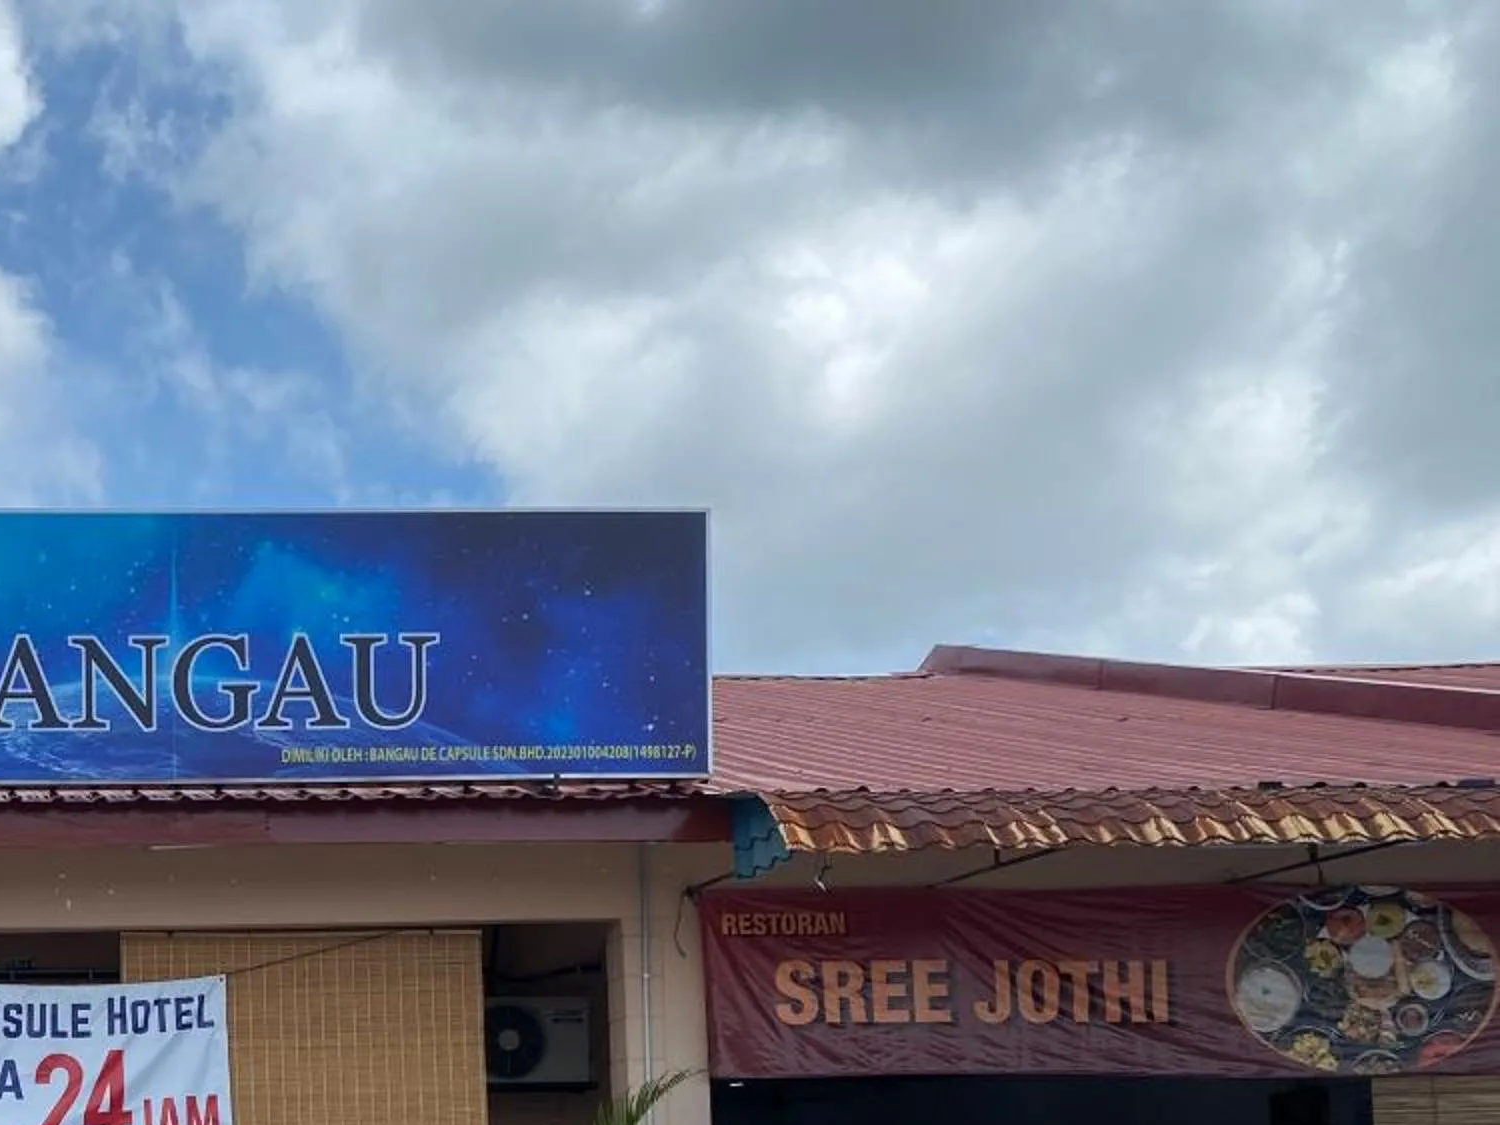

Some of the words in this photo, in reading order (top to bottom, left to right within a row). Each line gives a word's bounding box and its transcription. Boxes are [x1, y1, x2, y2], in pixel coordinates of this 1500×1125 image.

[421, 746, 437, 761] DE
[438, 745, 490, 761] CAPSULE
[721, 911, 846, 936] RESTORAN
[774, 958, 953, 1025] SREE
[972, 958, 1169, 1024] JOTHI
[108, 993, 215, 1036] HOTEL
